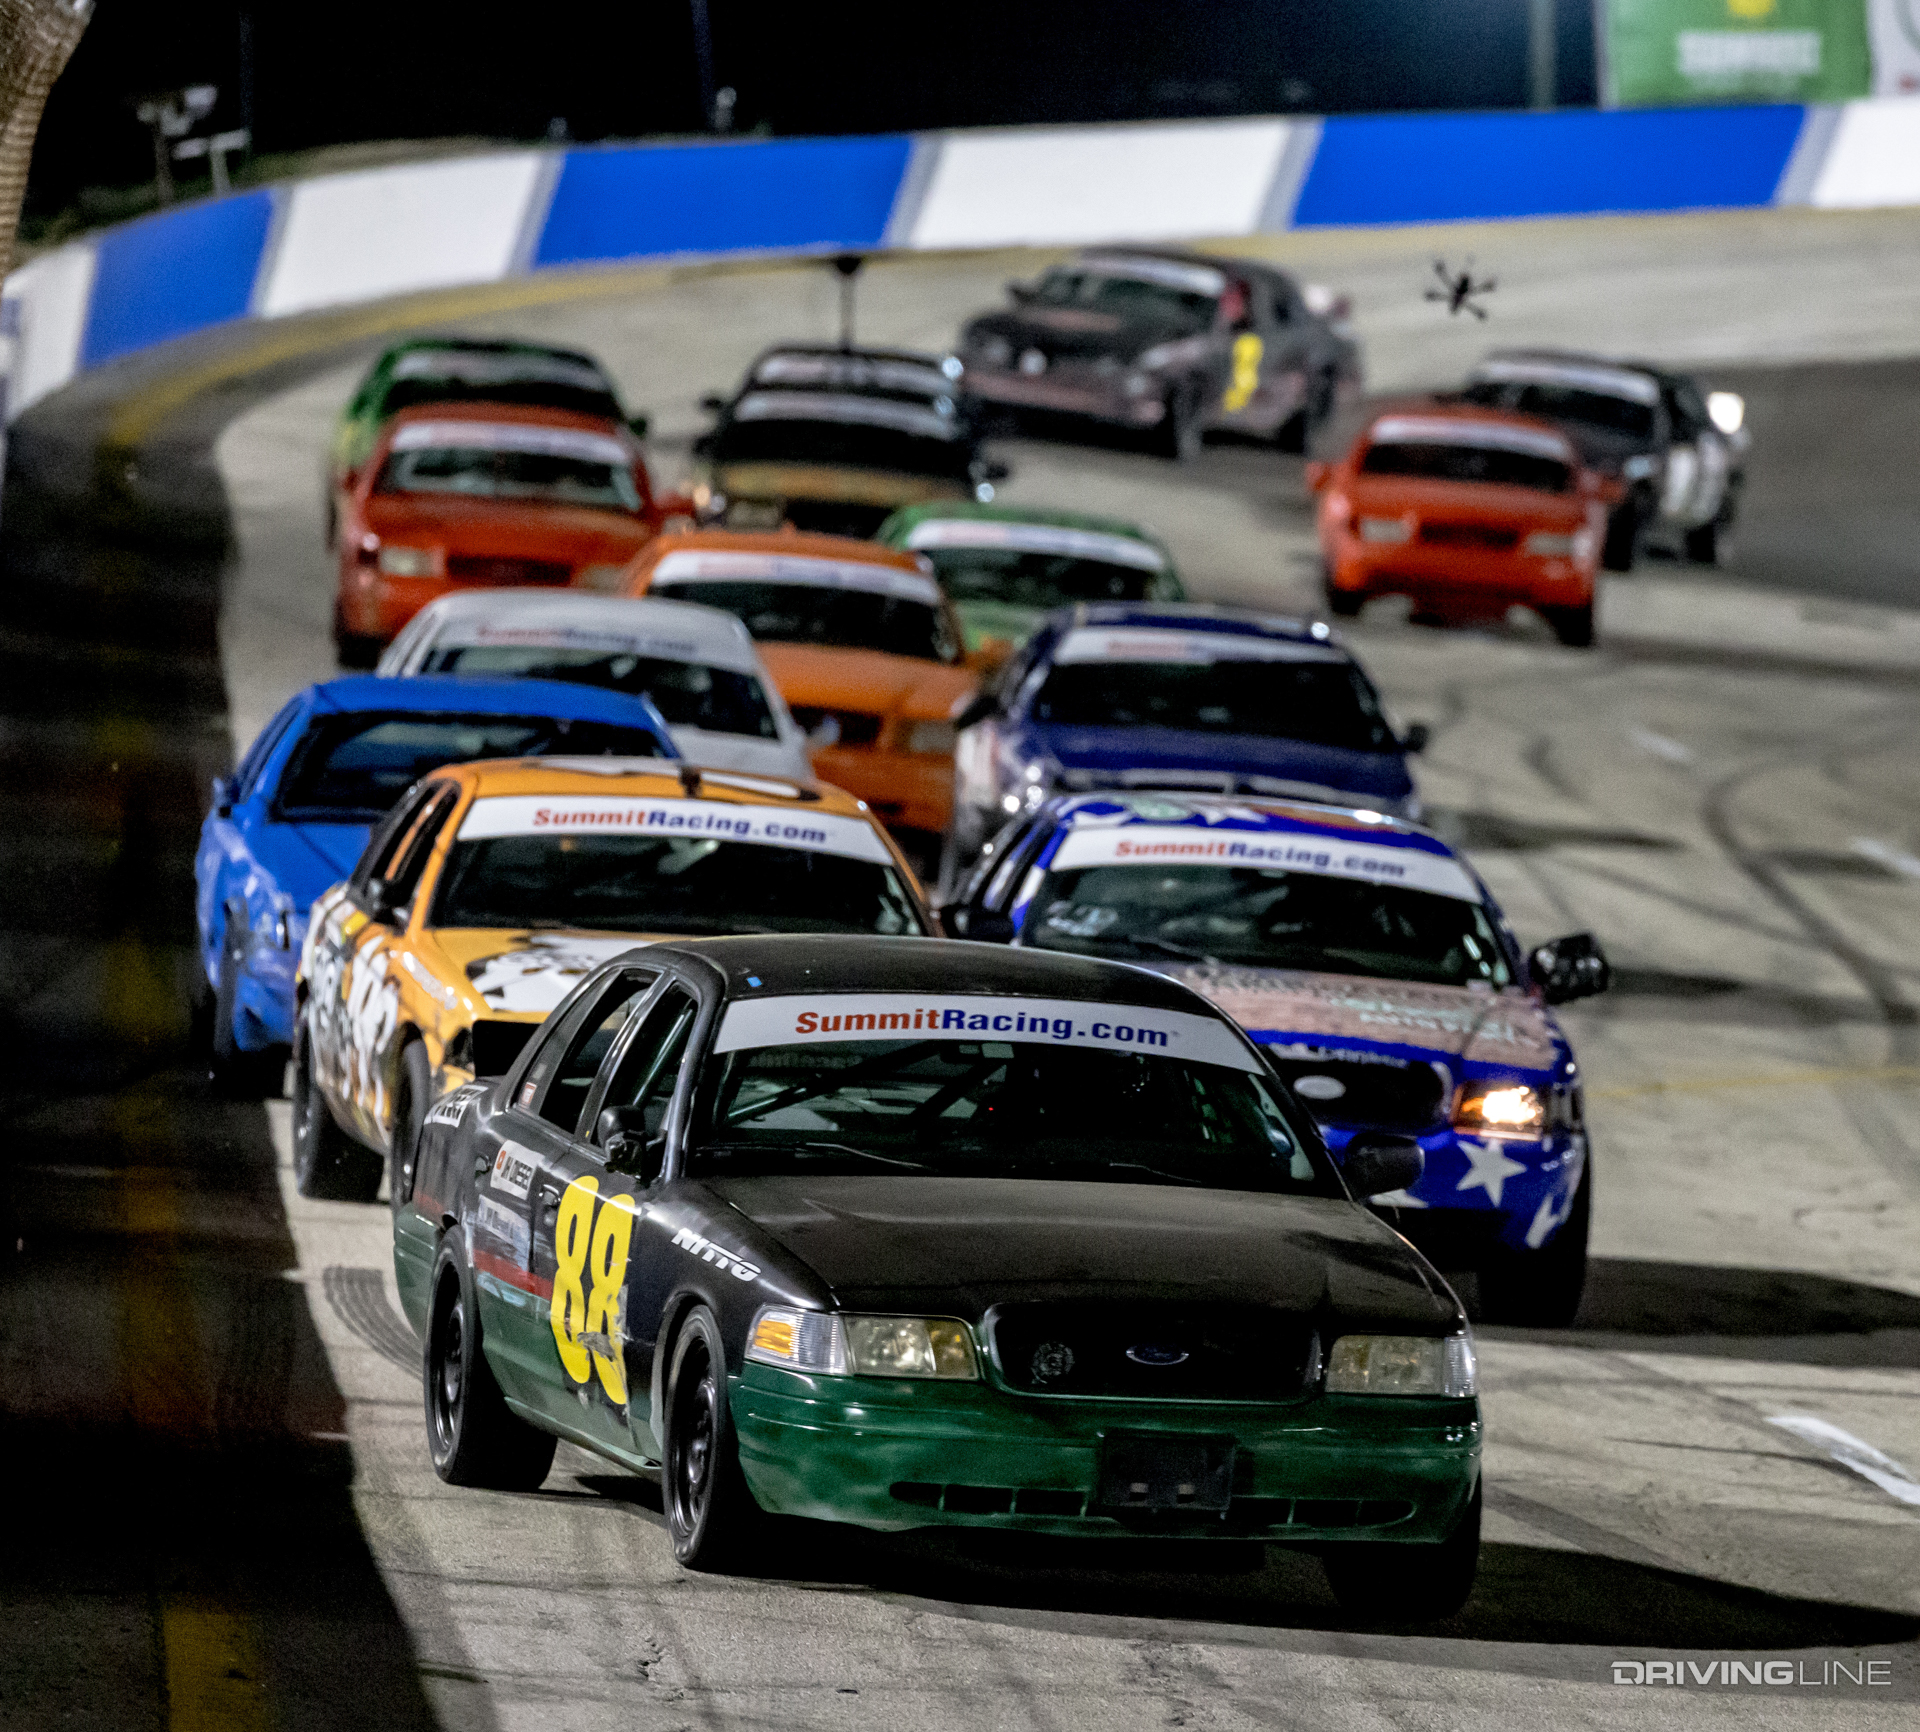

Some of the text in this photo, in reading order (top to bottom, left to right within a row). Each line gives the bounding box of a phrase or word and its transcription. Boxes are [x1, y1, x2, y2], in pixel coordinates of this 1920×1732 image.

[533, 808, 827, 843] SummitRacing.com
[1116, 841, 1405, 877] SummitRacing.com
[796, 1009, 1168, 1047] SummitRacing.com
[671, 1227, 762, 1282] NITTO
[550, 1175, 635, 1405] 88
